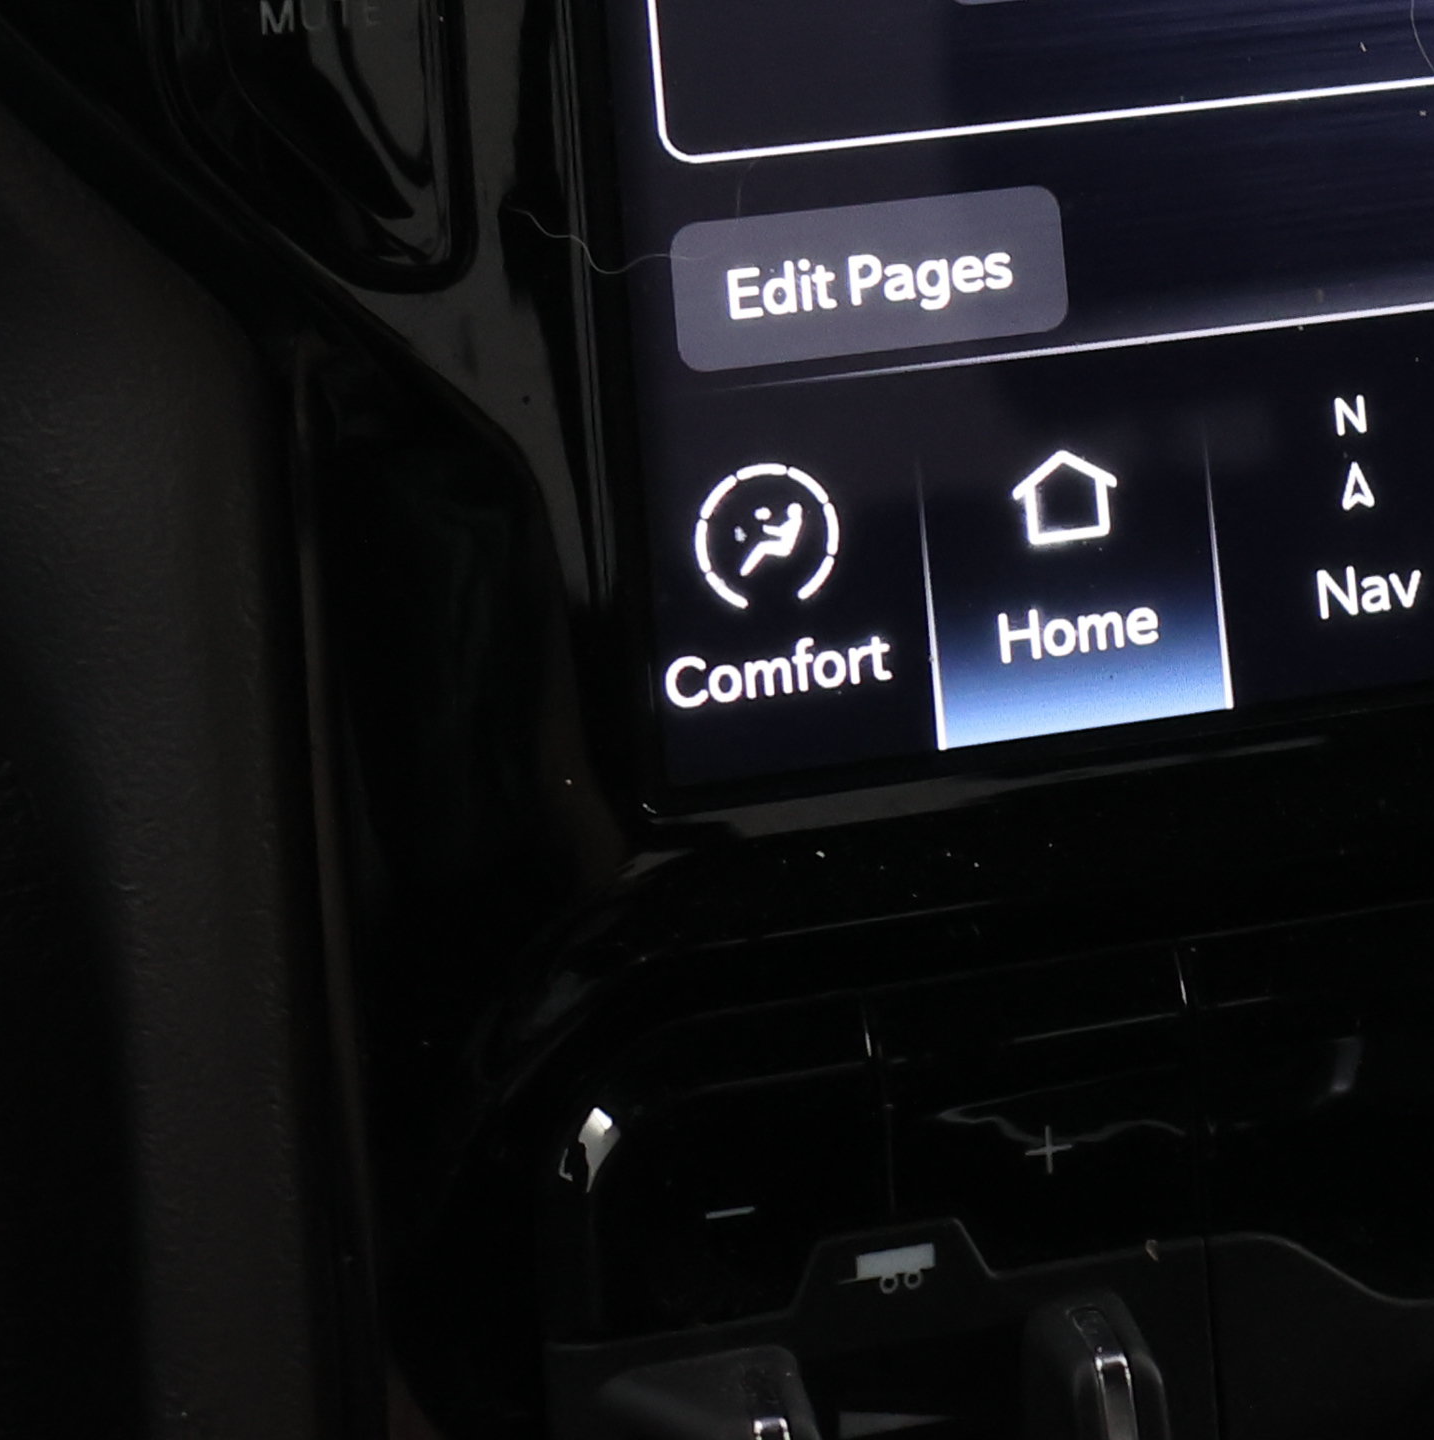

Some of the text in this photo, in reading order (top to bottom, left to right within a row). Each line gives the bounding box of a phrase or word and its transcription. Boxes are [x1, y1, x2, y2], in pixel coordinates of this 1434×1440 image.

[727, 253, 1012, 319] Edit Pages
[1335, 395, 1367, 435] N
[1317, 566, 1421, 619] Nav
[998, 607, 1158, 664] Home
[666, 636, 892, 708] Comfort
